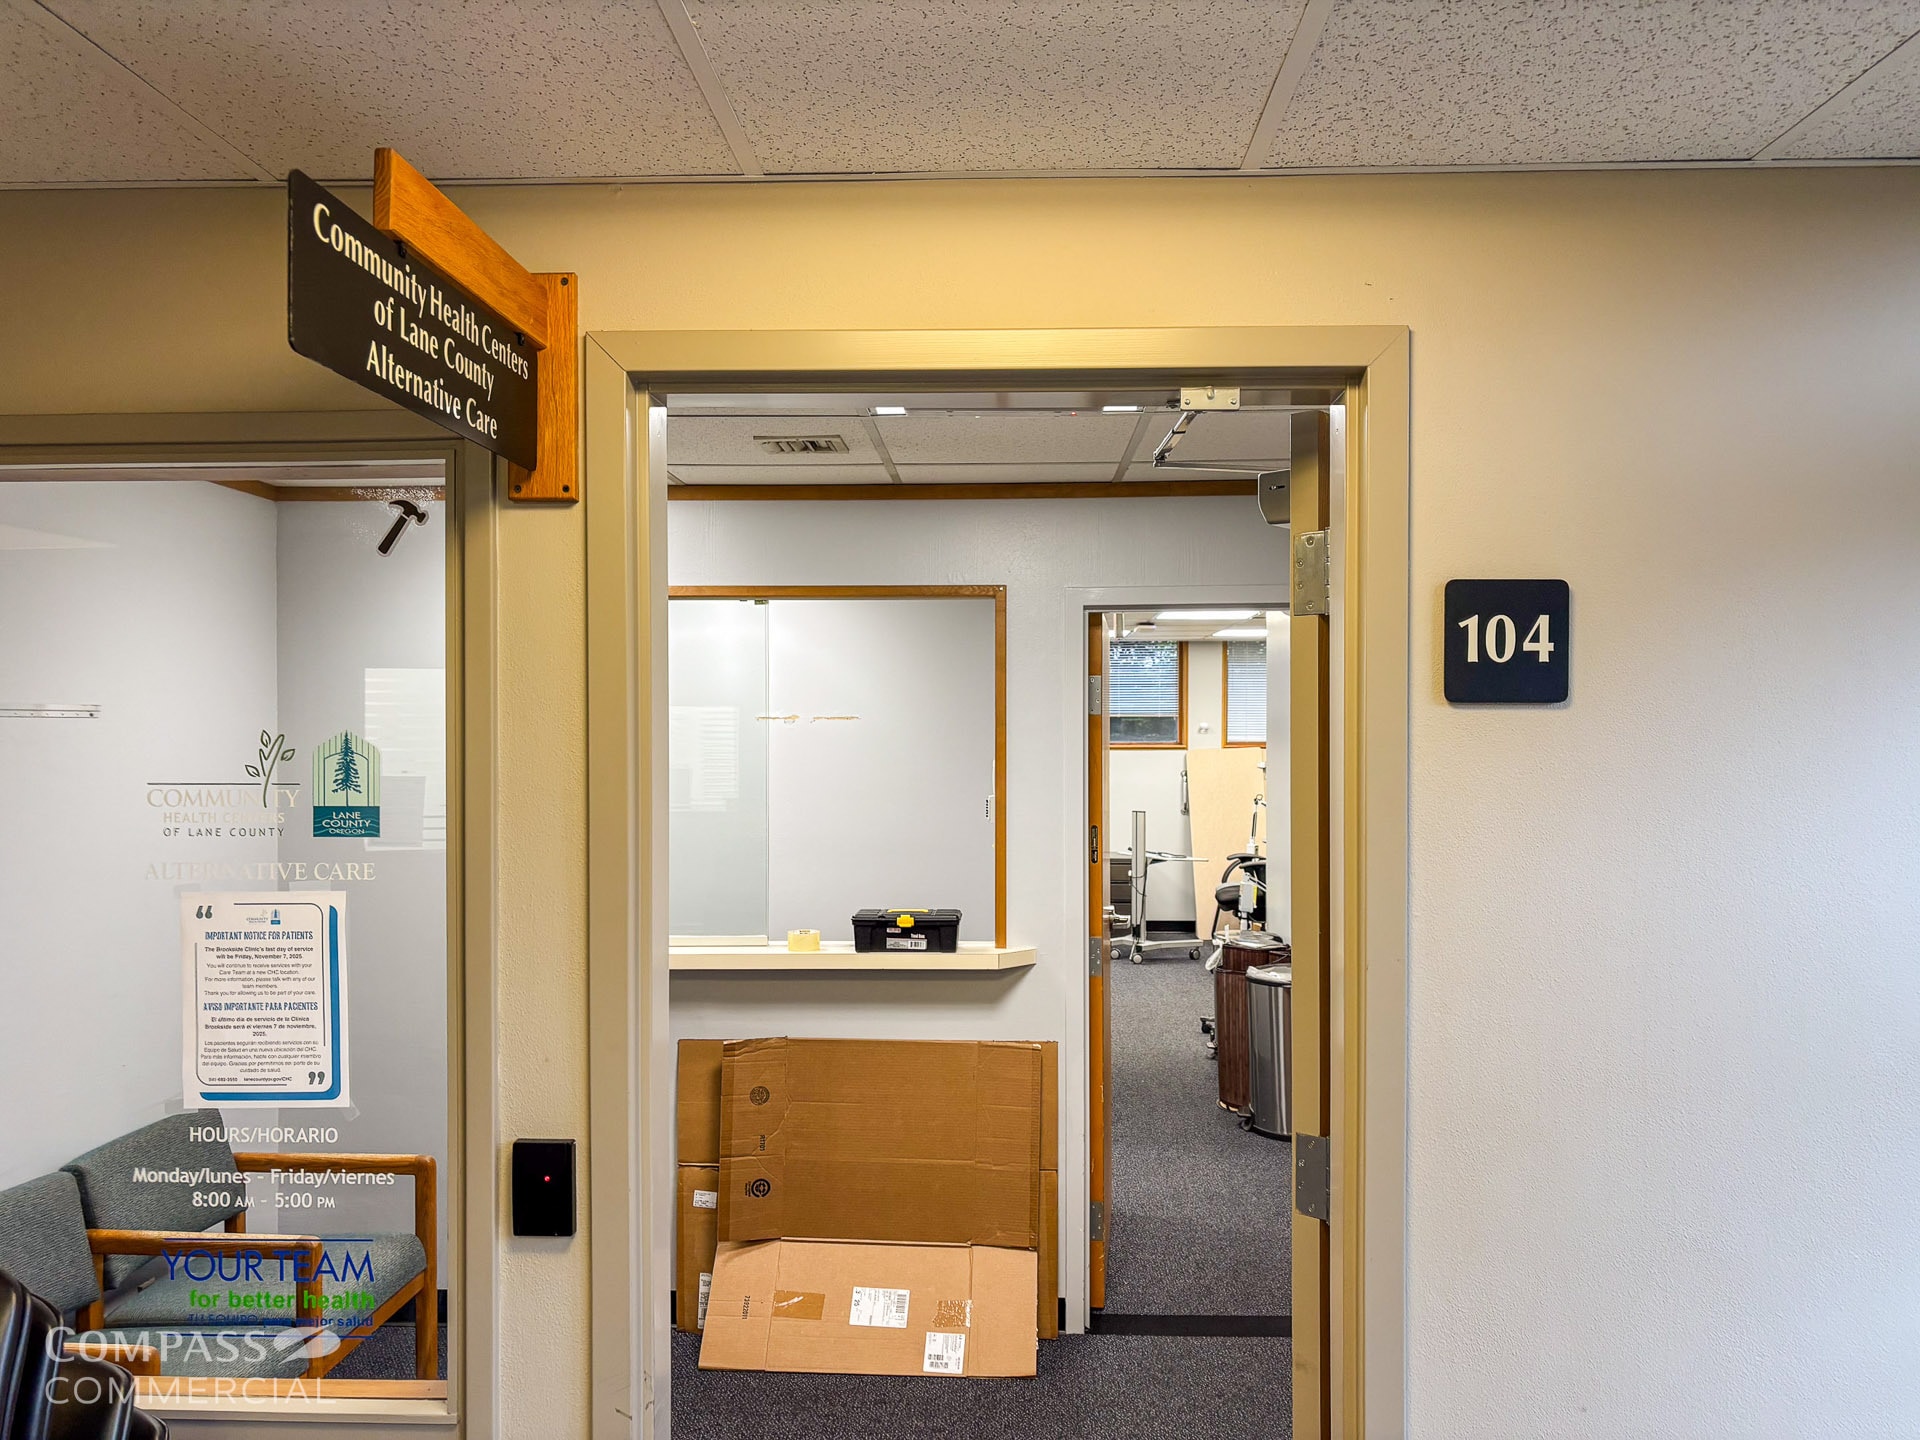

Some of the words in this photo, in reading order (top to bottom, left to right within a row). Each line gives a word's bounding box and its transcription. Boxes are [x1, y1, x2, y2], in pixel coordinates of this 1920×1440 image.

[312, 203, 427, 318] Community
[430, 285, 479, 346] Health
[482, 325, 529, 380] Centers
[374, 298, 394, 331] of
[400, 308, 439, 359] Lane
[443, 338, 494, 401] County
[367, 341, 461, 420] Alternative
[466, 397, 498, 439] Care
[1458, 614, 1554, 663] 104
[146, 789, 300, 808] COMMUNITY
[163, 813, 216, 824] HEALTH
[223, 813, 285, 824] CENERS
[322, 819, 371, 828] COUNTY
[163, 828, 180, 837] OF
[188, 828, 222, 837] LANE
[230, 828, 284, 837] COUNTY
[146, 863, 308, 881] ALTERNATIVE
[314, 863, 376, 881] CARE
[205, 931, 242, 940] IMPORTANT
[244, 931, 267, 940] NOTICE
[268, 931, 281, 940] FOR
[282, 931, 313, 940] PATIENTS
[203, 1002, 222, 1011] AVISO
[224, 1002, 264, 1011] IMPORTANTE
[265, 1002, 283, 1011] PARA
[284, 1002, 319, 1011] PACIENTES
[189, 1127, 338, 1144] HOURS/HORARIO
[133, 1167, 251, 1186] Monday/lunes
[270, 1167, 395, 1186] Friday/viernes
[192, 1192, 230, 1208] 8:00
[234, 1198, 255, 1208] AM
[274, 1192, 313, 1208] 5:00
[317, 1198, 336, 1208] PM
[161, 1249, 264, 1282] YOUR
[279, 1249, 375, 1282] TEAM
[189, 1290, 219, 1309] for
[229, 1290, 294, 1309] better
[304, 1290, 375, 1309] health
[296, 1317, 333, 1327] mejor
[337, 1315, 373, 1327] salud
